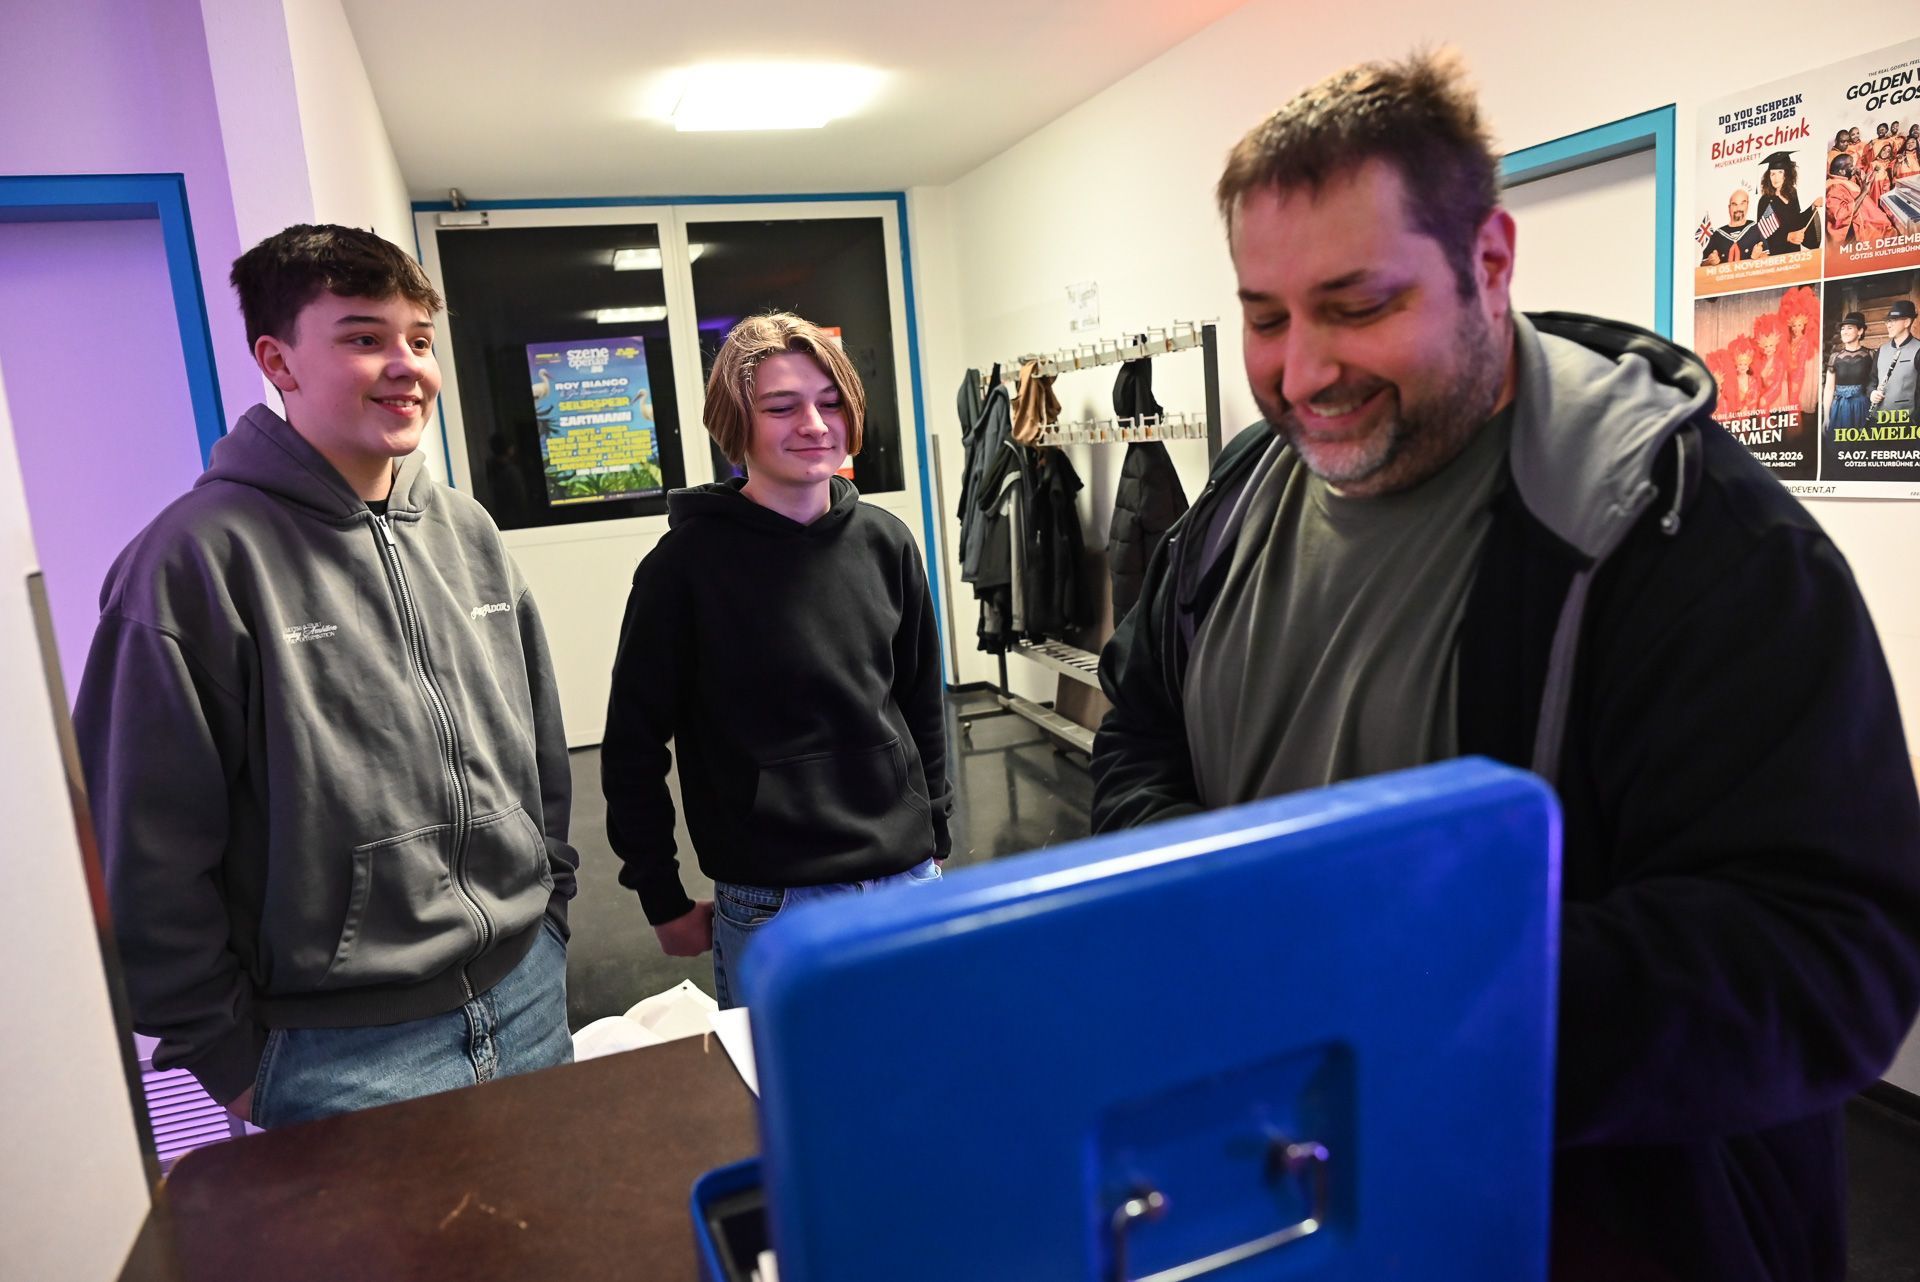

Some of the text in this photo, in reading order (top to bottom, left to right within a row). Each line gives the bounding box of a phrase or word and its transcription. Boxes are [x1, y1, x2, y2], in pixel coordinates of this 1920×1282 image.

[1890, 62, 1909, 71] GOSPEL
[1846, 69, 1913, 100] GOLDEN
[1718, 93, 1803, 126] DO YOU SCHPEAK
[1865, 94, 1888, 111] OF
[1725, 107, 1796, 134] DEITSCH 2025
[1711, 117, 1810, 160] Bluatschink
[1839, 232, 1920, 254] MI 03. DEZEMB
[1849, 244, 1920, 261] GÖTZIS KULTURBÜHN
[1734, 255, 1787, 272] NOVEMBER
[1788, 251, 1813, 263] 2025
[566, 347, 609, 359] szene
[555, 381, 579, 391] ROY
[1719, 412, 1799, 434] ERRLICHE
[1876, 408, 1910, 424] DIE
[1733, 428, 1782, 446] AMEN
[1750, 451, 1804, 461] RUAR 2026
[1844, 460, 1867, 468] GÖTZIS
[1867, 459, 1913, 467] KULTURBÜHNE
[1871, 450, 1920, 460] FEBRUAR
[1784, 485, 1836, 494] NDEVENT.AT
